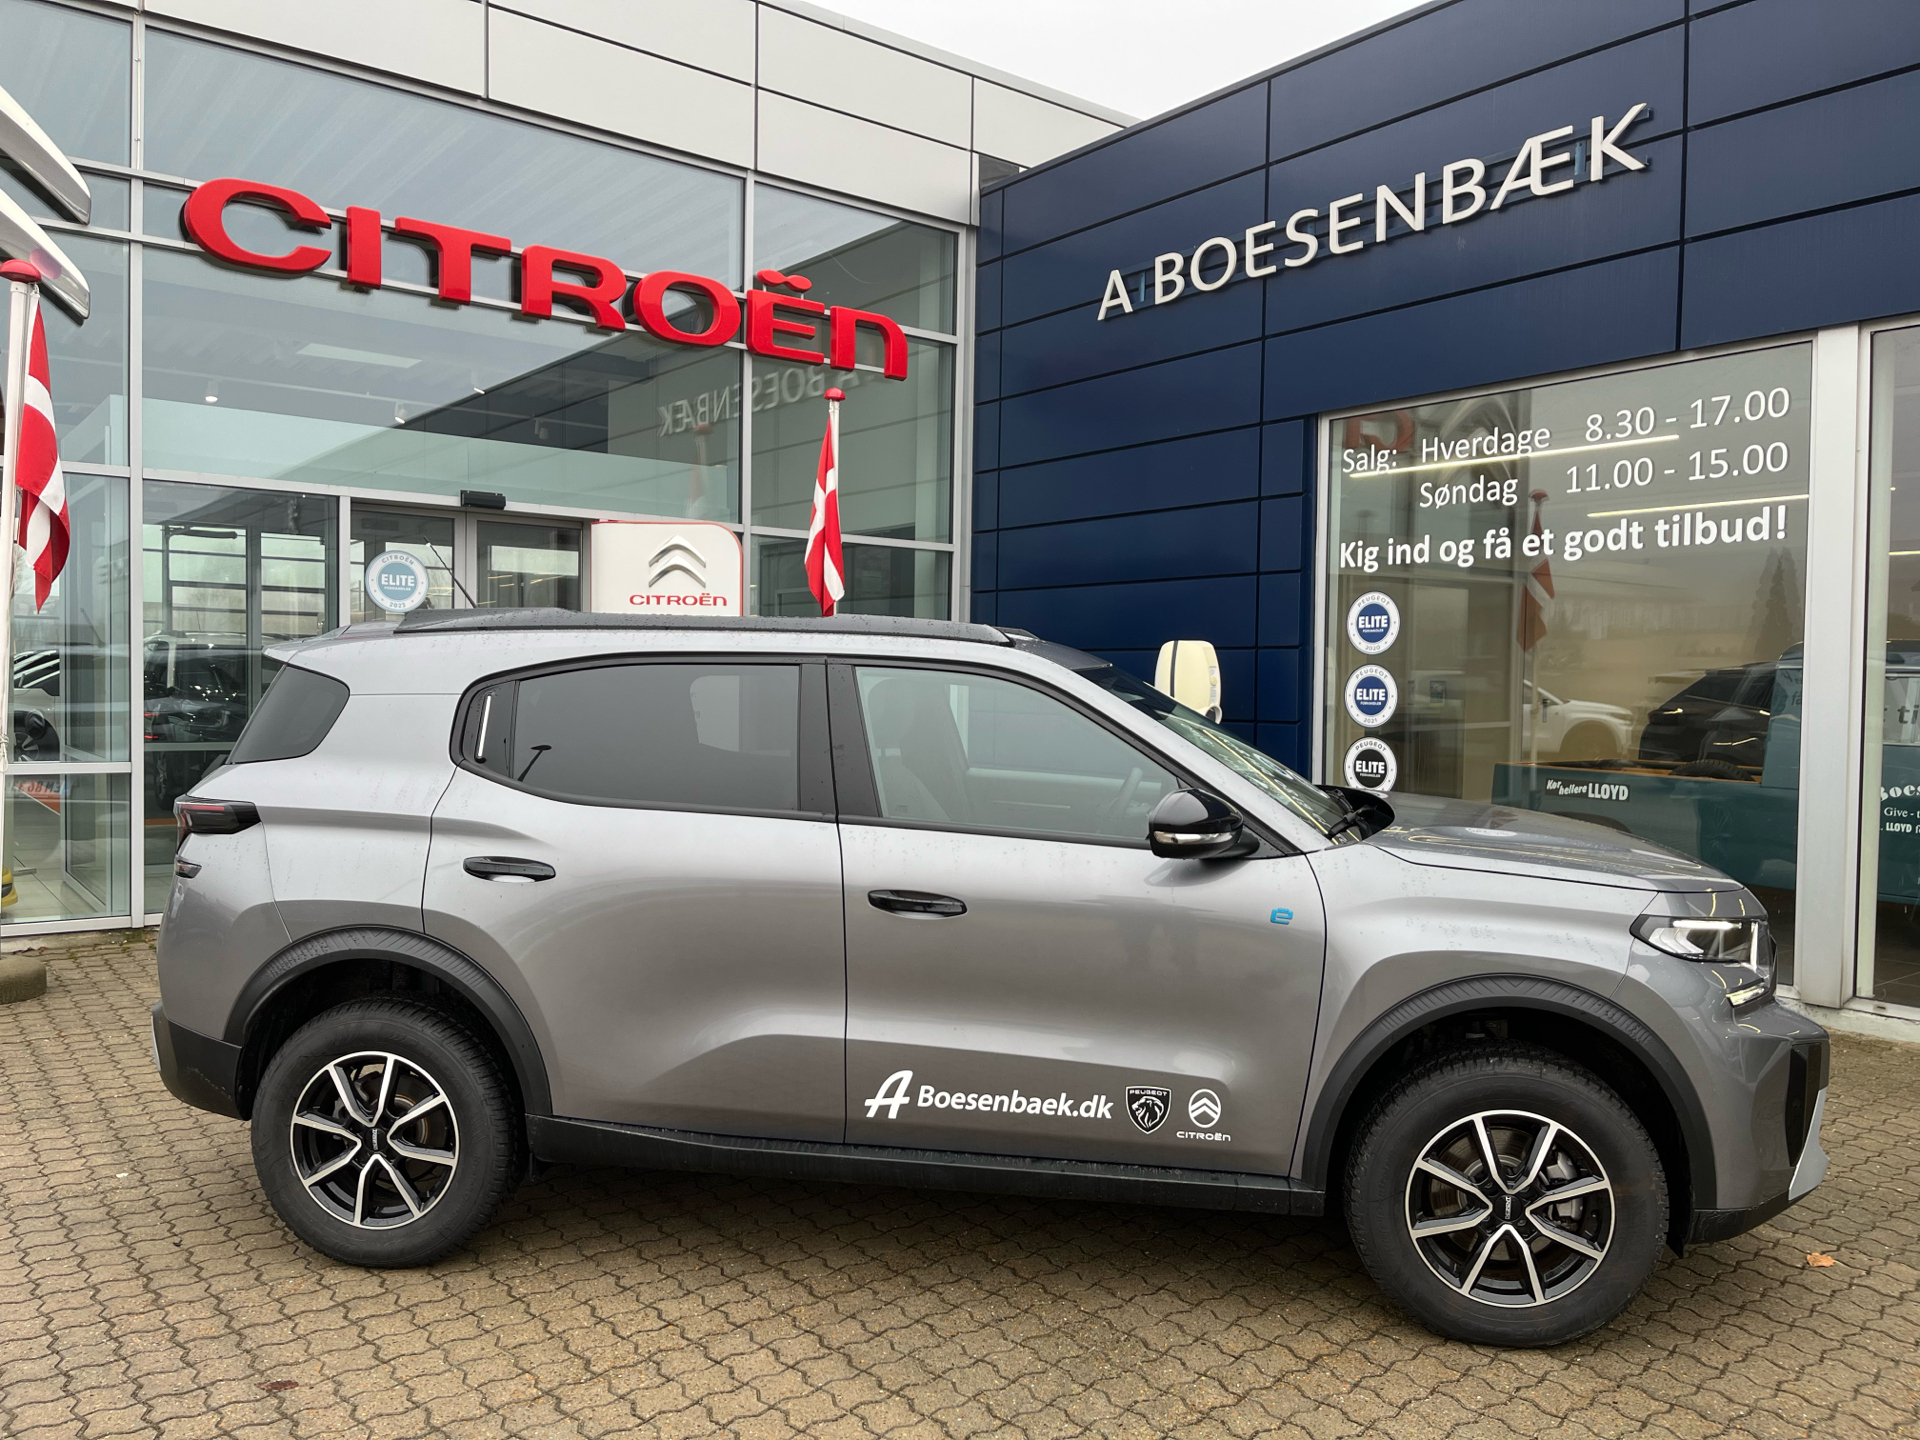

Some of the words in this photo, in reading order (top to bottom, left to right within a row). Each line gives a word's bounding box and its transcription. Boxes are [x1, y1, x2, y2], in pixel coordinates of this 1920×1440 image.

[1097, 269, 1134, 321] A
[1153, 102, 1649, 306] BOESENBÆK
[183, 177, 909, 381] CITROËN
[1342, 443, 1398, 475] Salg:
[1421, 426, 1551, 464] Hverdage
[1585, 406, 1655, 442] 8.30
[1690, 387, 1791, 429] 17.00
[1419, 474, 1519, 510] Søndag
[1566, 457, 1654, 494] 11.00
[1688, 441, 1789, 481] 15.00
[1340, 540, 1380, 573] Kig
[1387, 534, 1431, 566] ind
[1439, 538, 1475, 568] og
[1483, 526, 1513, 560] få
[1522, 528, 1555, 557] et
[1563, 518, 1644, 561] godt
[1654, 504, 1787, 549] tilbud!
[381, 573, 415, 587] ELITE
[629, 592, 728, 607] CITROËN
[1357, 594, 1390, 607] PEUGEOT
[1358, 615, 1388, 629] ELITE
[1355, 668, 1388, 680] PEUGEOT
[1356, 688, 1386, 701] ELITE
[1355, 740, 1387, 752] PEUGEOT
[1355, 760, 1386, 774] ELITE
[1558, 784, 1588, 796] hellere
[1587, 782, 1629, 801] LLOYD
[1883, 806, 1909, 818] Give
[1885, 821, 1913, 833] LLOYD
[1129, 1089, 1168, 1097] PEUGEOT
[917, 1084, 1114, 1120] Boesenbaek.dk
[1176, 1131, 1231, 1142] CITROËN
